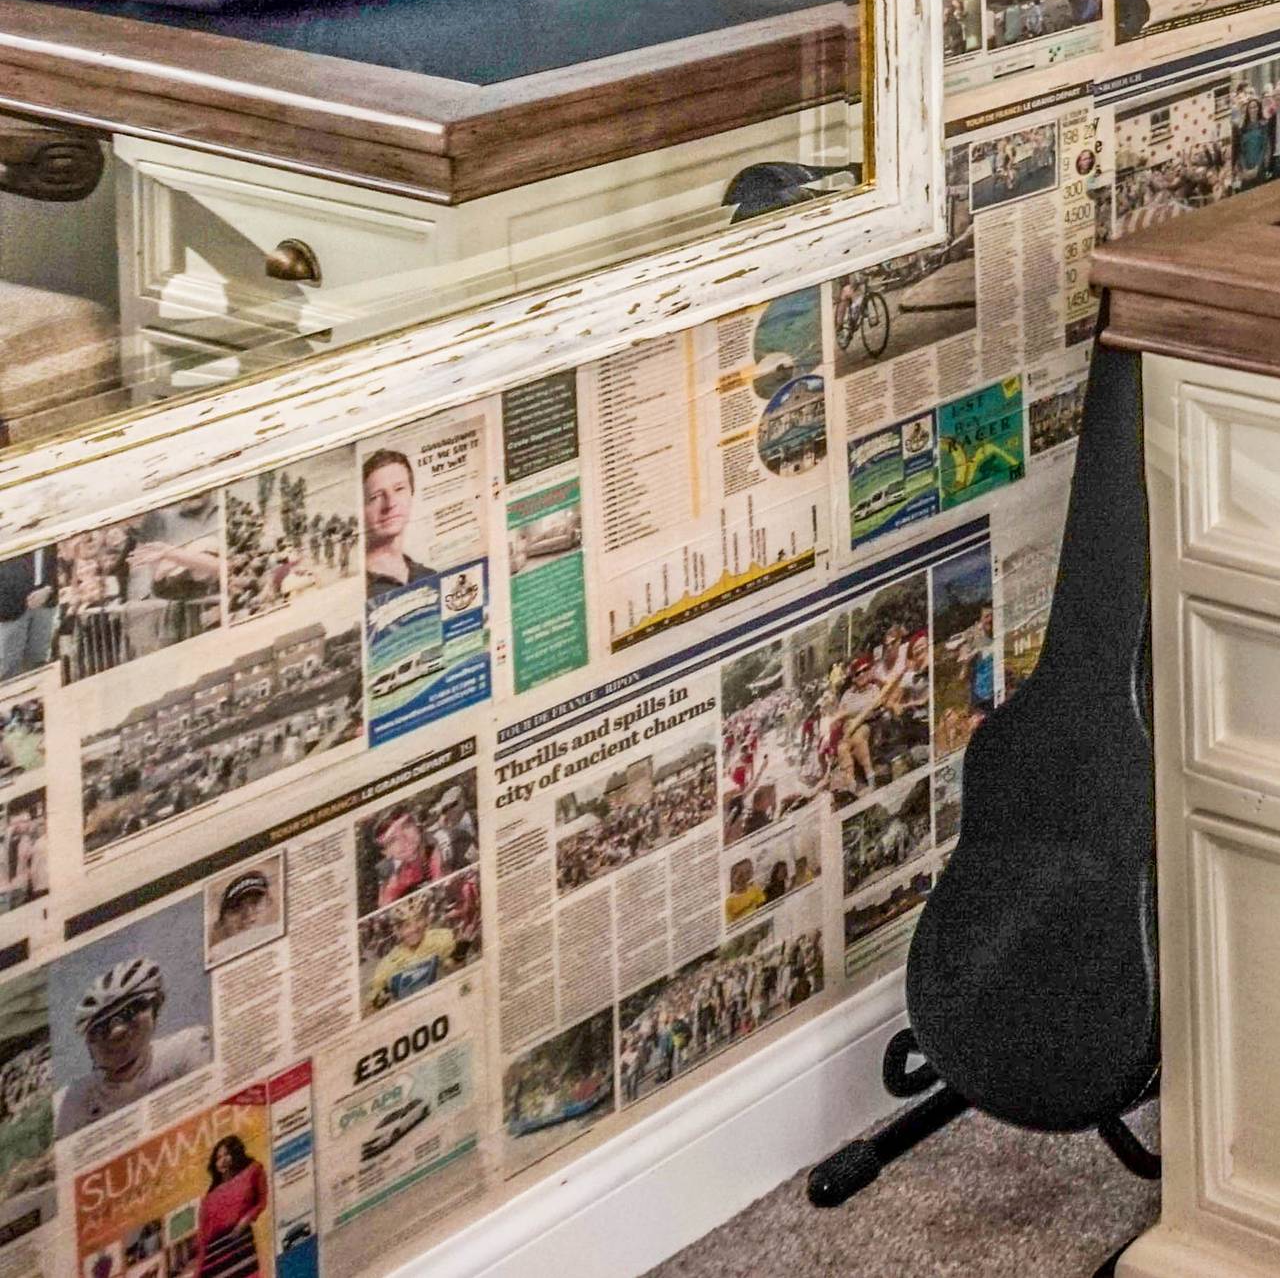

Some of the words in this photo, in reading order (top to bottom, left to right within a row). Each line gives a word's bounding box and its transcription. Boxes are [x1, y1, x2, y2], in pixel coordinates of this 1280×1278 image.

[1063, 180, 1083, 200] 300
[494, 741, 568, 786] Thrills
[571, 719, 610, 749] and
[613, 697, 667, 732] spills
[669, 686, 689, 706] in
[500, 722, 532, 742] TOUR
[534, 713, 549, 726] DE
[551, 691, 598, 718] FRANCE
[604, 672, 641, 694] RIPON
[494, 776, 536, 809] city
[539, 762, 564, 789] of
[564, 731, 640, 773] ancient
[643, 696, 716, 741] charms
[354, 1014, 450, 1086] £3,000
